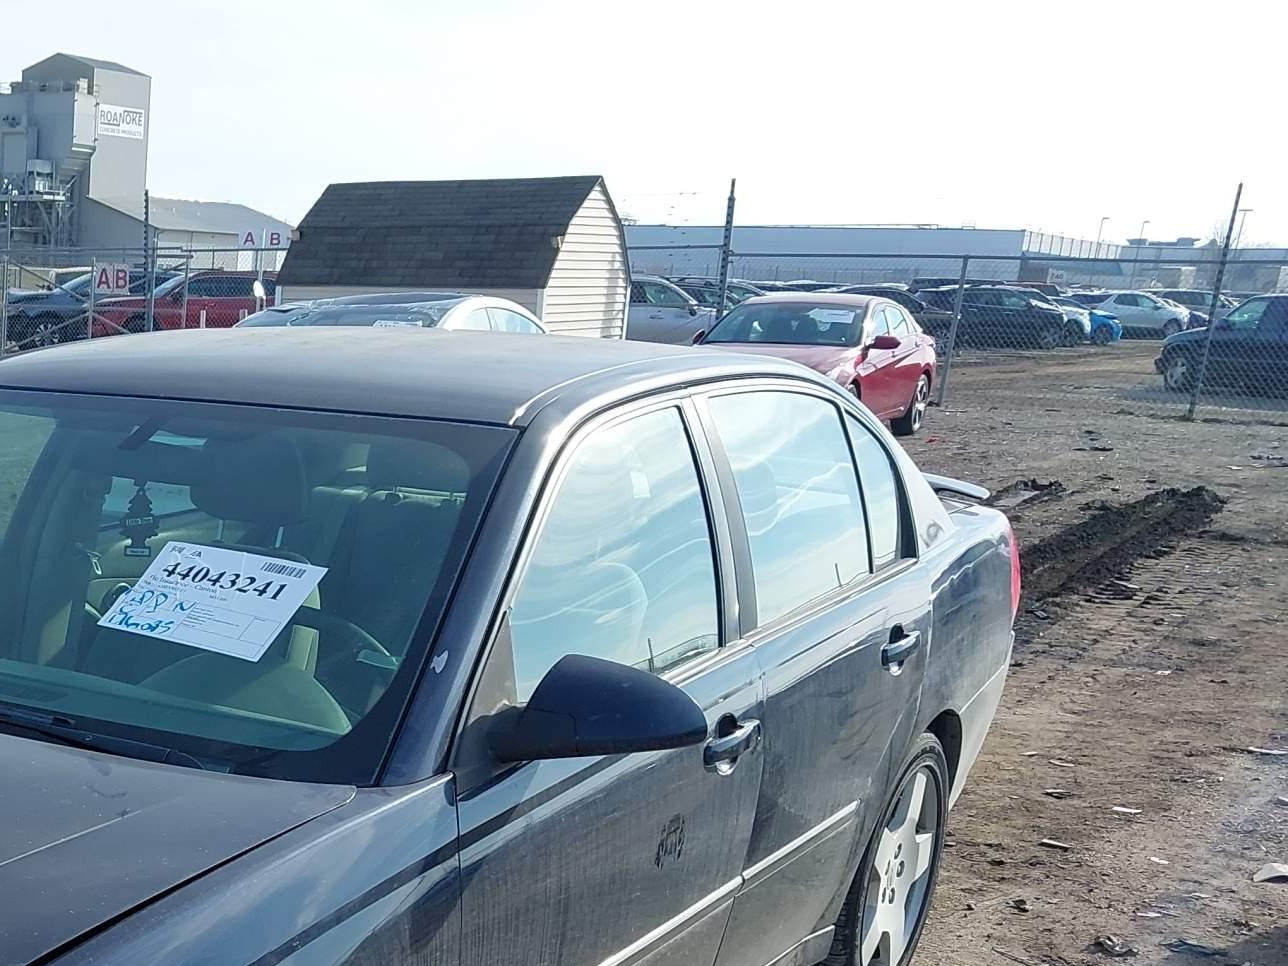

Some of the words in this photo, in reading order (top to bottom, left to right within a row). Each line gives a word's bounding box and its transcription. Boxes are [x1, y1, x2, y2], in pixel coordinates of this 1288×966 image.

[100, 110, 143, 127] ROANOKE
[243, 231, 255, 246] A
[269, 232, 281, 246] B
[97, 267, 111, 289] A
[115, 269, 128, 289] B
[162, 561, 289, 601] 44043241
